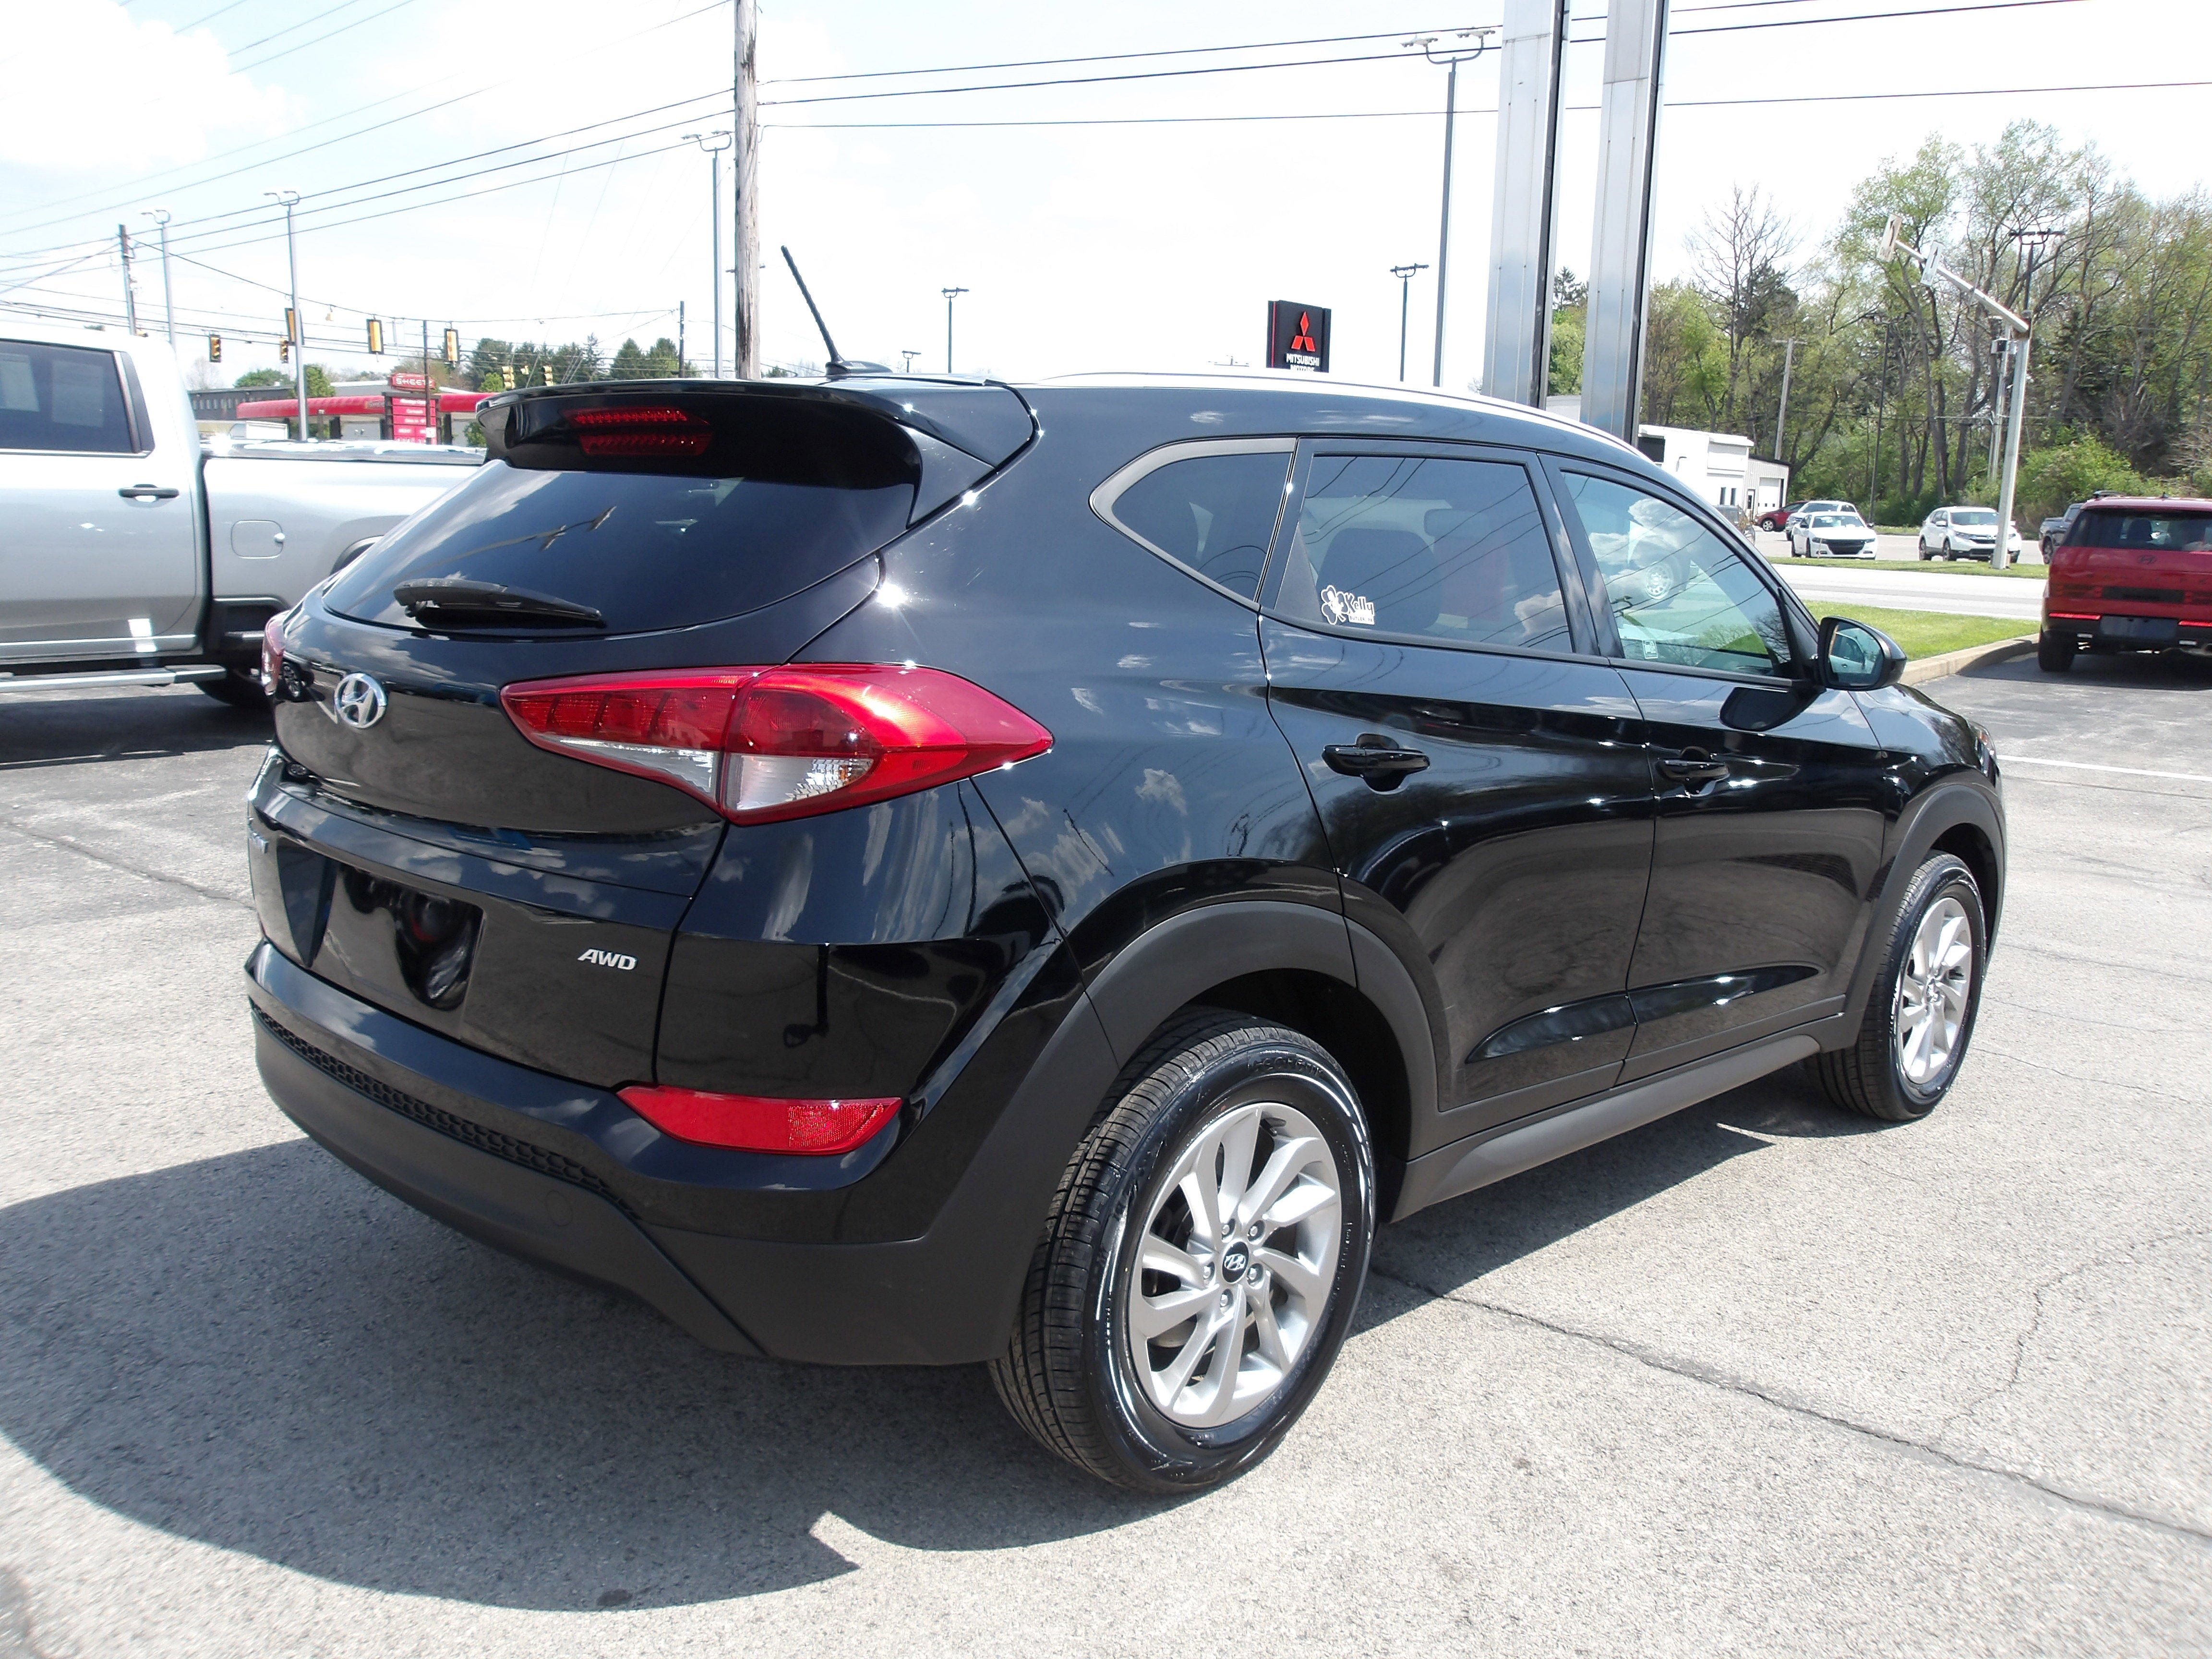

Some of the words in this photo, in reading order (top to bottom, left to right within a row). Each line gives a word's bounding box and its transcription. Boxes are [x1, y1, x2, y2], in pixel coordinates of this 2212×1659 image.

[1286, 353, 1320, 366] MITSUBISHI
[1345, 594, 1373, 615] Kelly
[577, 948, 637, 970] AWD
